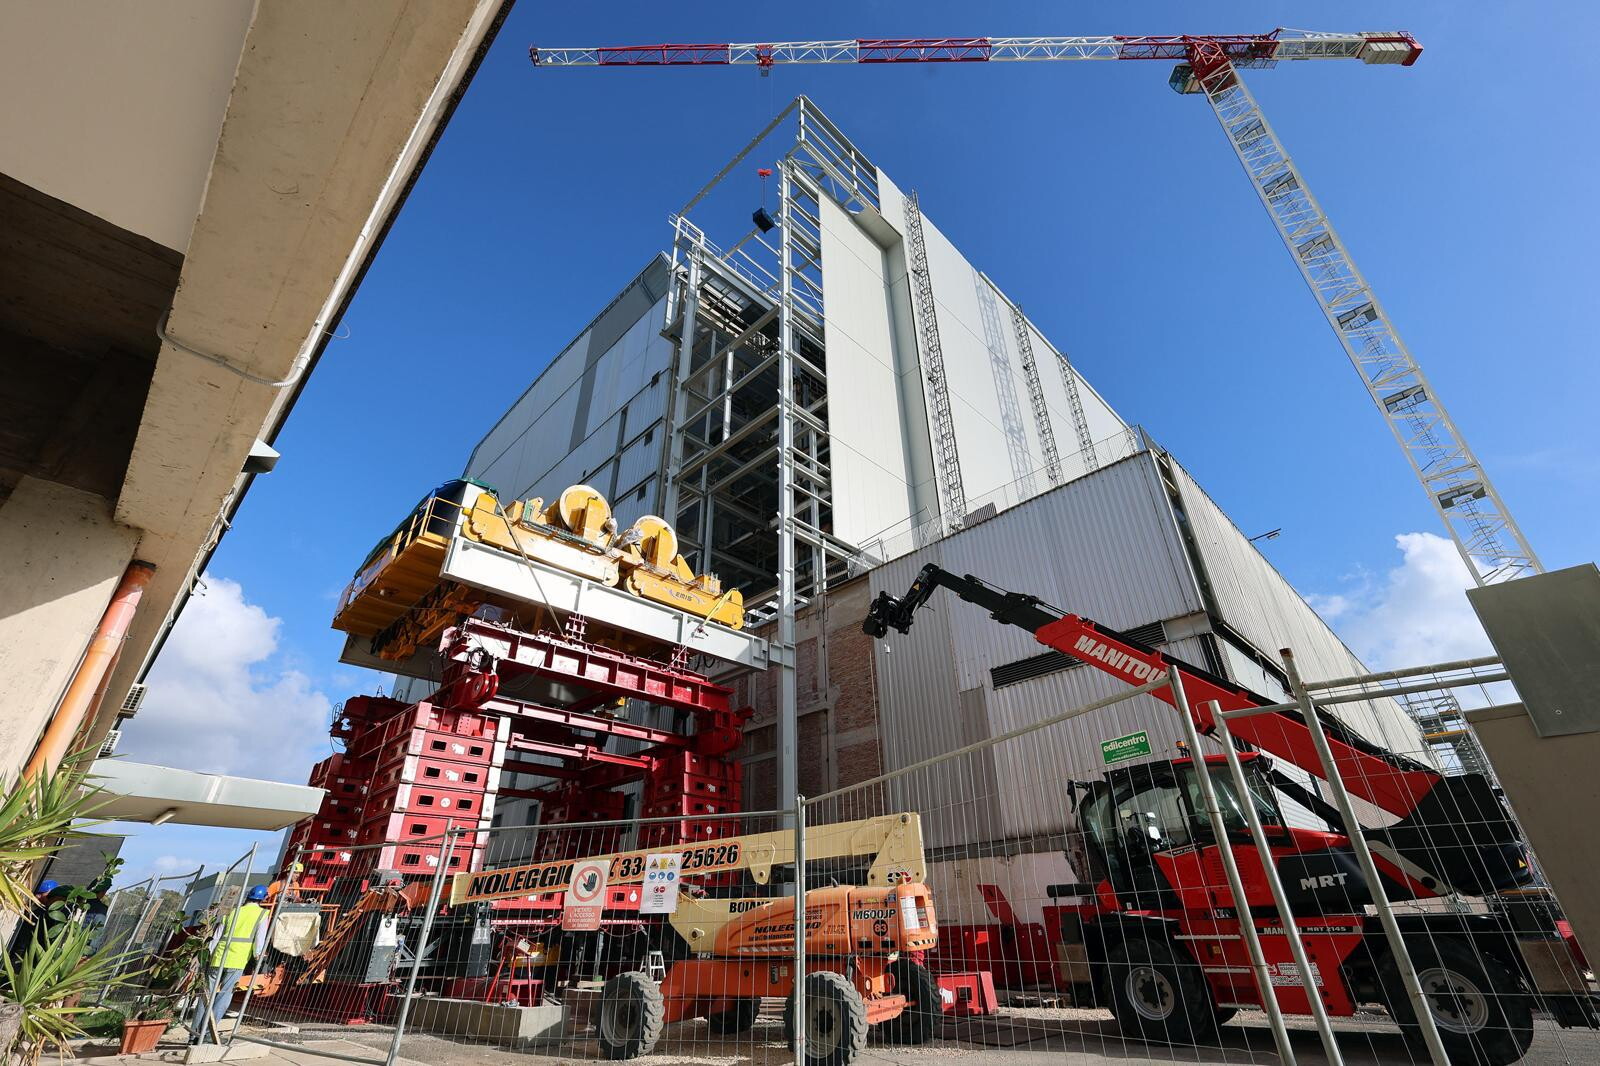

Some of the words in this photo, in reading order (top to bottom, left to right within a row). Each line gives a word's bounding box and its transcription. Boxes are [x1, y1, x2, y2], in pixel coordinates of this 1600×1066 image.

[1073, 634, 1167, 684] MANITOU
[1103, 735, 1146, 752] edilcentro
[681, 844, 739, 870] 25626
[1300, 872, 1348, 891] MRT
[729, 901, 771, 914] BOIA
[852, 908, 897, 921] M600JP
[755, 920, 822, 935] NOLEGIO
[874, 923, 887, 933] 83
